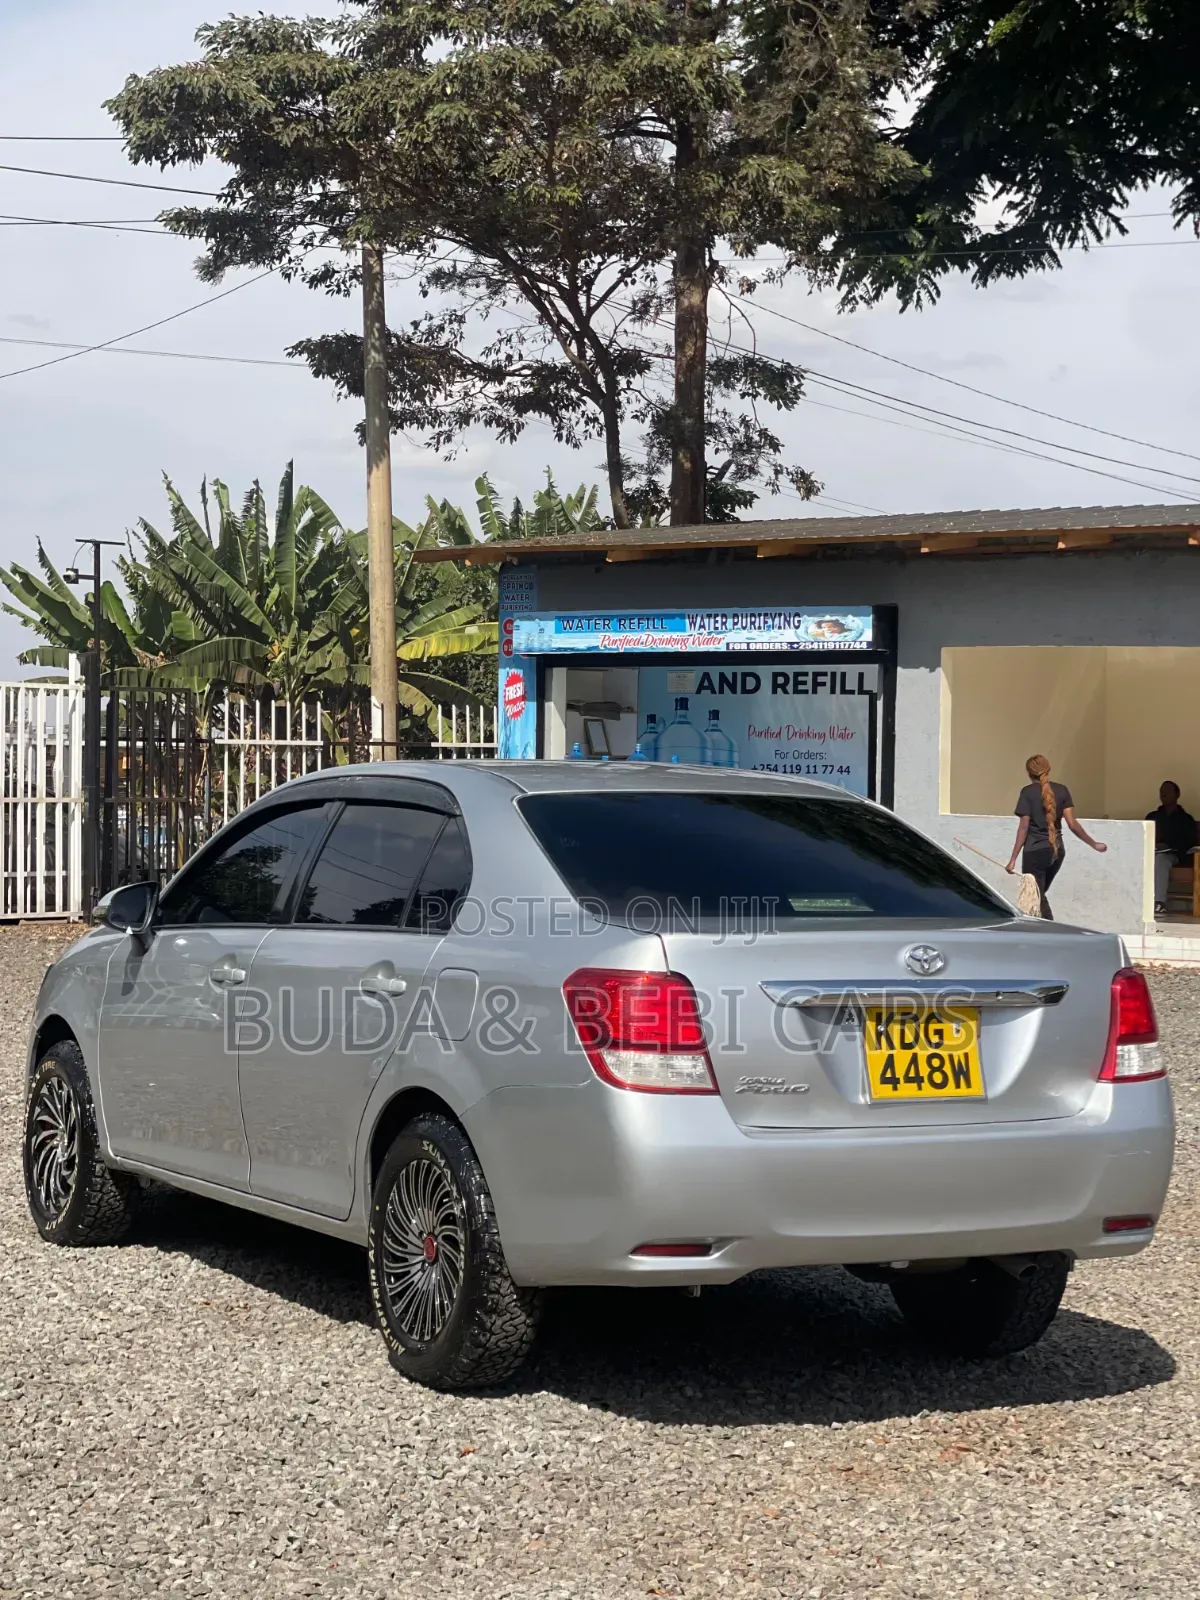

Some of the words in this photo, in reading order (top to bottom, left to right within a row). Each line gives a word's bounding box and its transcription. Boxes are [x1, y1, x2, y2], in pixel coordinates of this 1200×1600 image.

[502, 582, 534, 591] SPRINGS
[504, 593, 530, 602] WATER
[562, 618, 611, 632] WATER
[618, 617, 668, 631] REFILL
[687, 613, 728, 631] WATER
[732, 612, 801, 631] PURIFYING
[600, 634, 642, 650] Purified
[644, 633, 689, 650] Drinking
[692, 631, 725, 646] Water
[749, 642, 791, 650] ORDERS:
[792, 641, 867, 650] +254119117744
[505, 682, 525, 701] FRESH
[695, 671, 762, 695] AND
[771, 671, 876, 695] REFILL
[748, 724, 783, 741] Purified
[785, 724, 826, 745] Drinking
[829, 724, 857, 741] Water
[774, 750, 789, 760] For
[793, 750, 827, 760] Orders:
[782, 764, 801, 774] 119
[806, 765, 818, 775] 11
[822, 765, 835, 775] 77
[837, 765, 851, 776] 44
[874, 1011, 945, 1051] KDG
[879, 1052, 972, 1092] 448W
